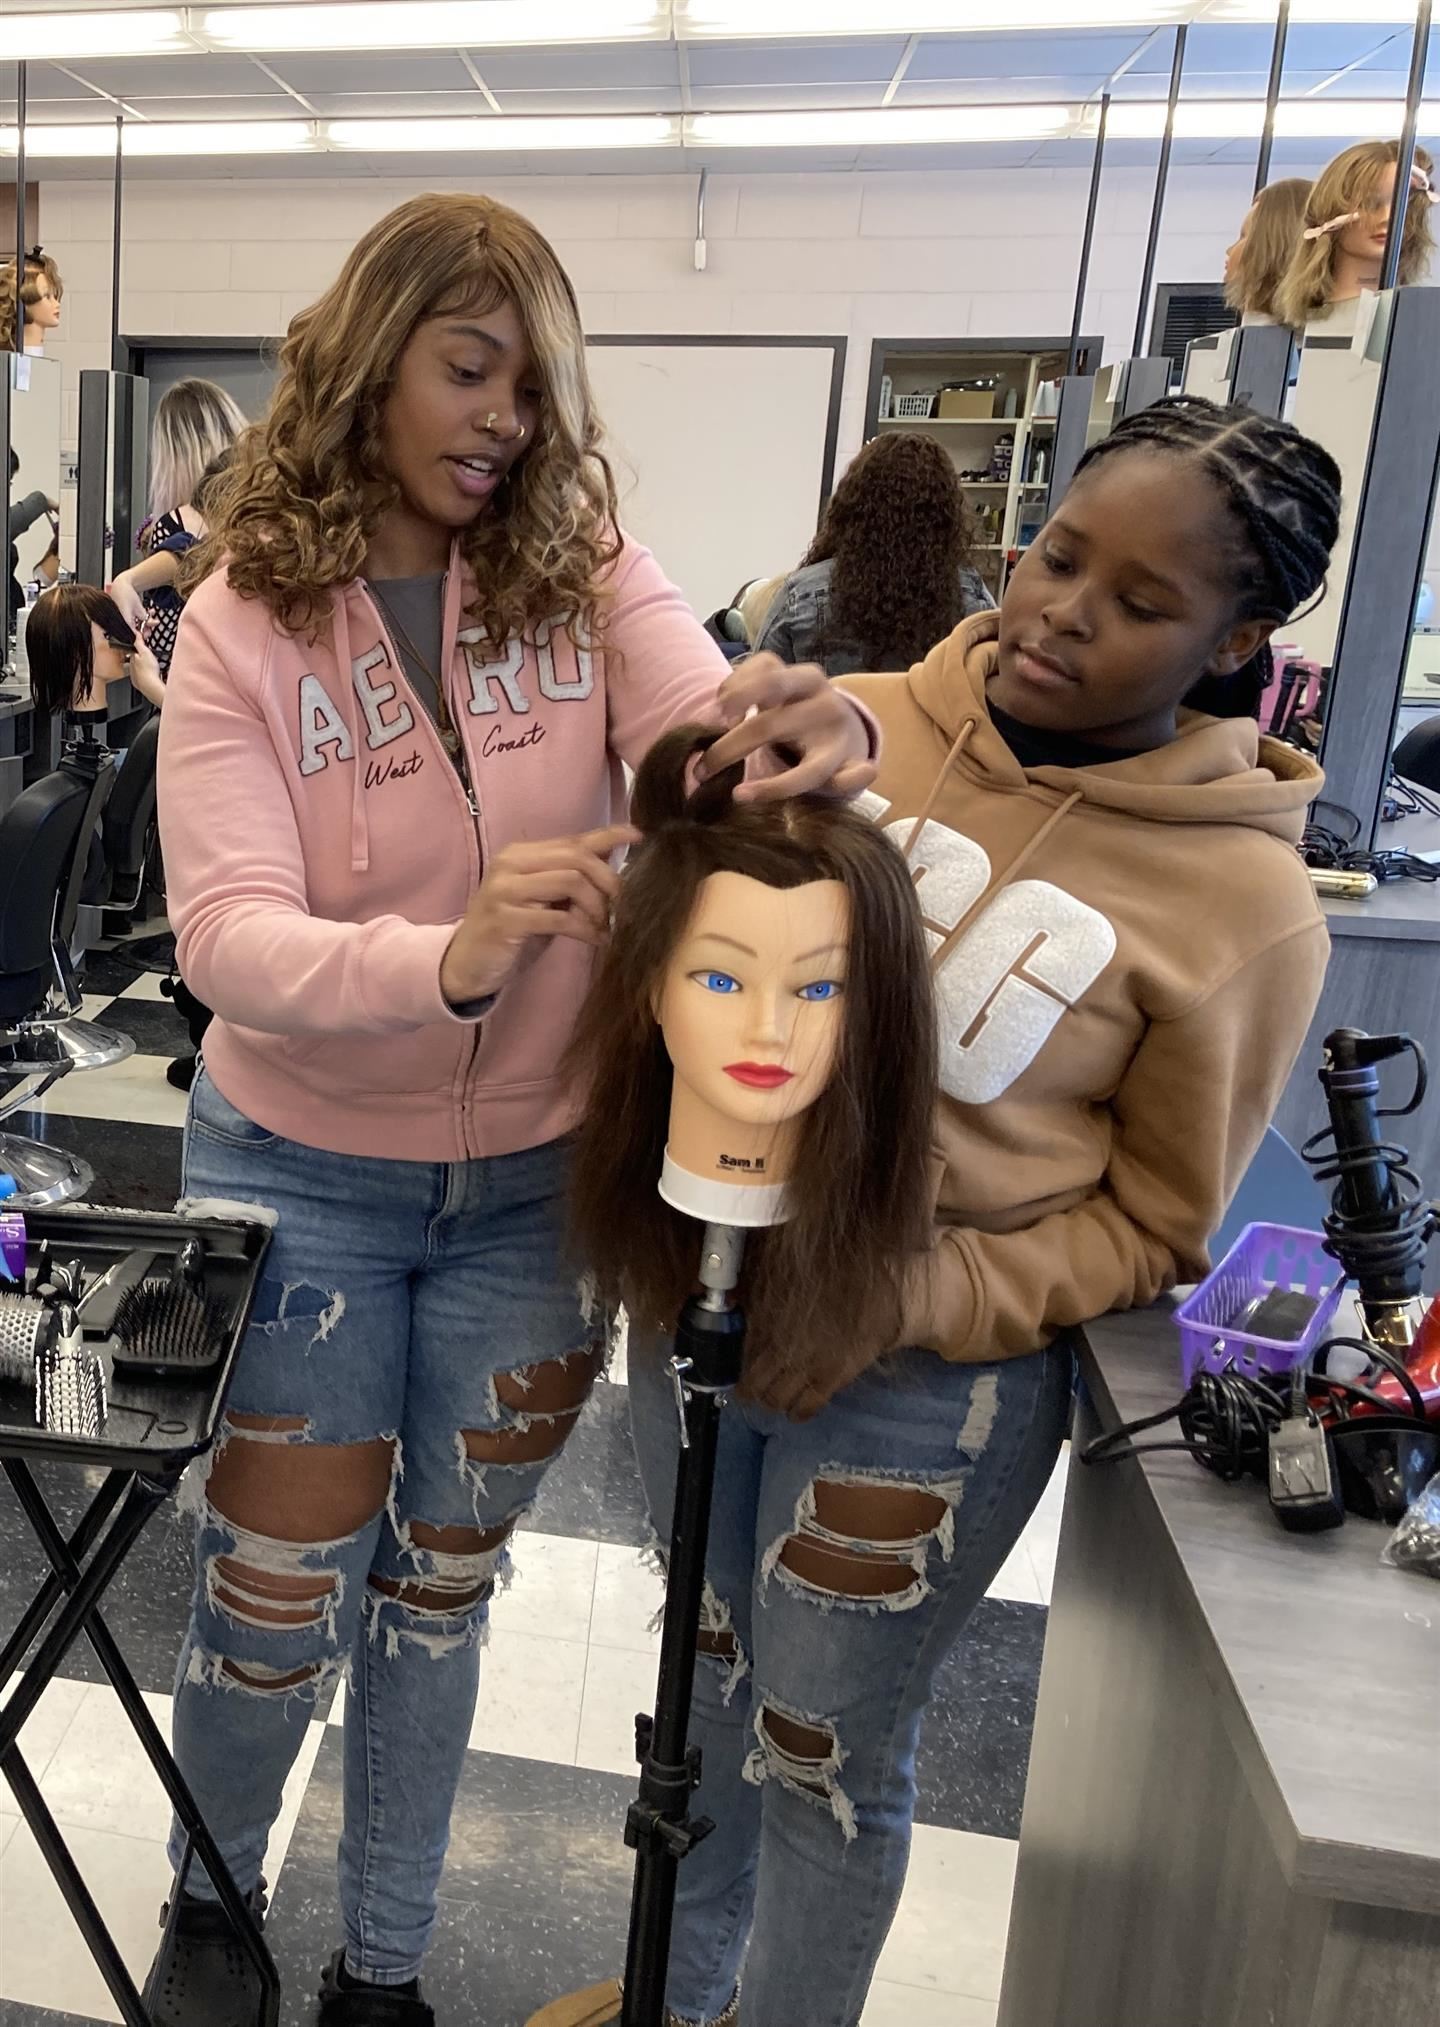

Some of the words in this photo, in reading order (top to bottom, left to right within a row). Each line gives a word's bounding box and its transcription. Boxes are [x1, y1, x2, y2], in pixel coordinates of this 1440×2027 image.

[364, 751, 424, 789] West
[482, 722, 546, 758] Coast
[719, 1154, 751, 1168] Sam
